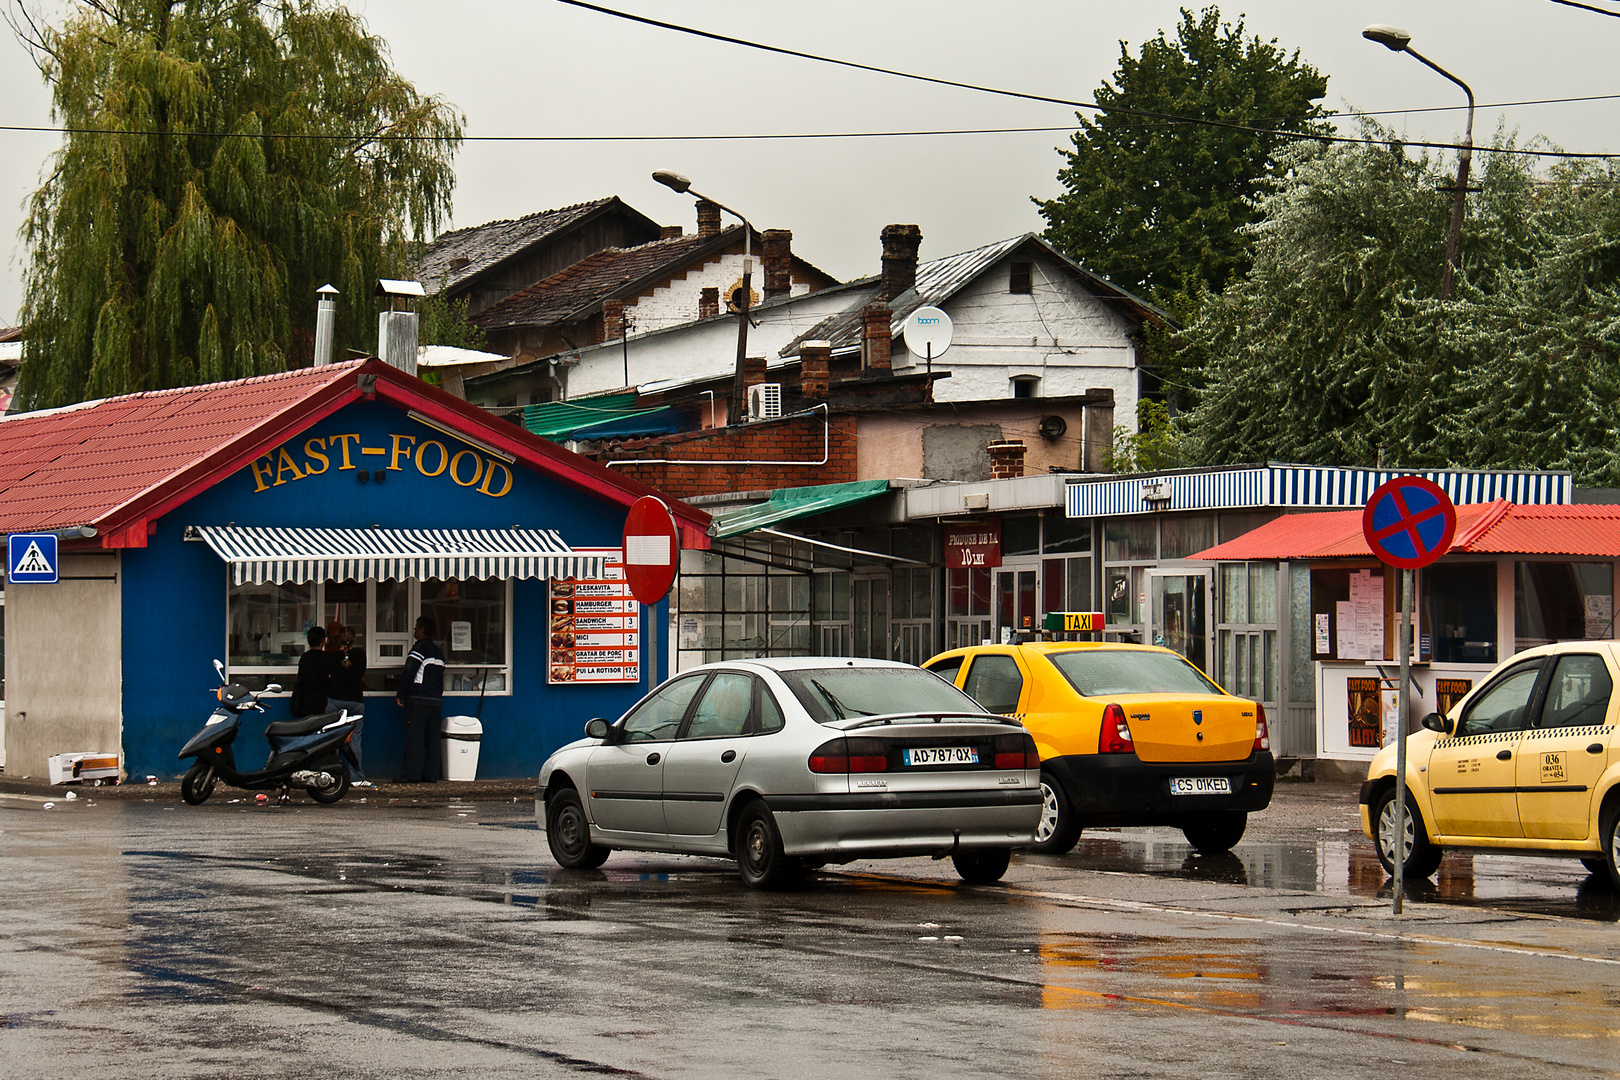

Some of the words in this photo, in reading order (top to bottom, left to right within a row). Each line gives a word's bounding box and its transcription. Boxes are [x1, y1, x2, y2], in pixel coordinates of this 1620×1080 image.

[917, 316, 940, 325] boom
[250, 433, 514, 497] FAST-FOOD
[948, 533, 978, 546] PRODUSE
[978, 533, 988, 545] DE
[988, 532, 999, 544] LA
[961, 548, 972, 566] 10
[972, 553, 985, 565] LEI
[628, 617, 633, 625] 3
[1066, 614, 1091, 630] TAXI
[628, 650, 633, 658] 8
[625, 667, 637, 675] 17,5
[1349, 679, 1361, 691] FAST
[1361, 679, 1376, 691] FOOD
[1436, 681, 1450, 693] FAST
[1450, 681, 1467, 694] FOOD
[1352, 728, 1361, 745] LA
[1545, 754, 1560, 765] 036
[1177, 778, 1193, 791] CS
